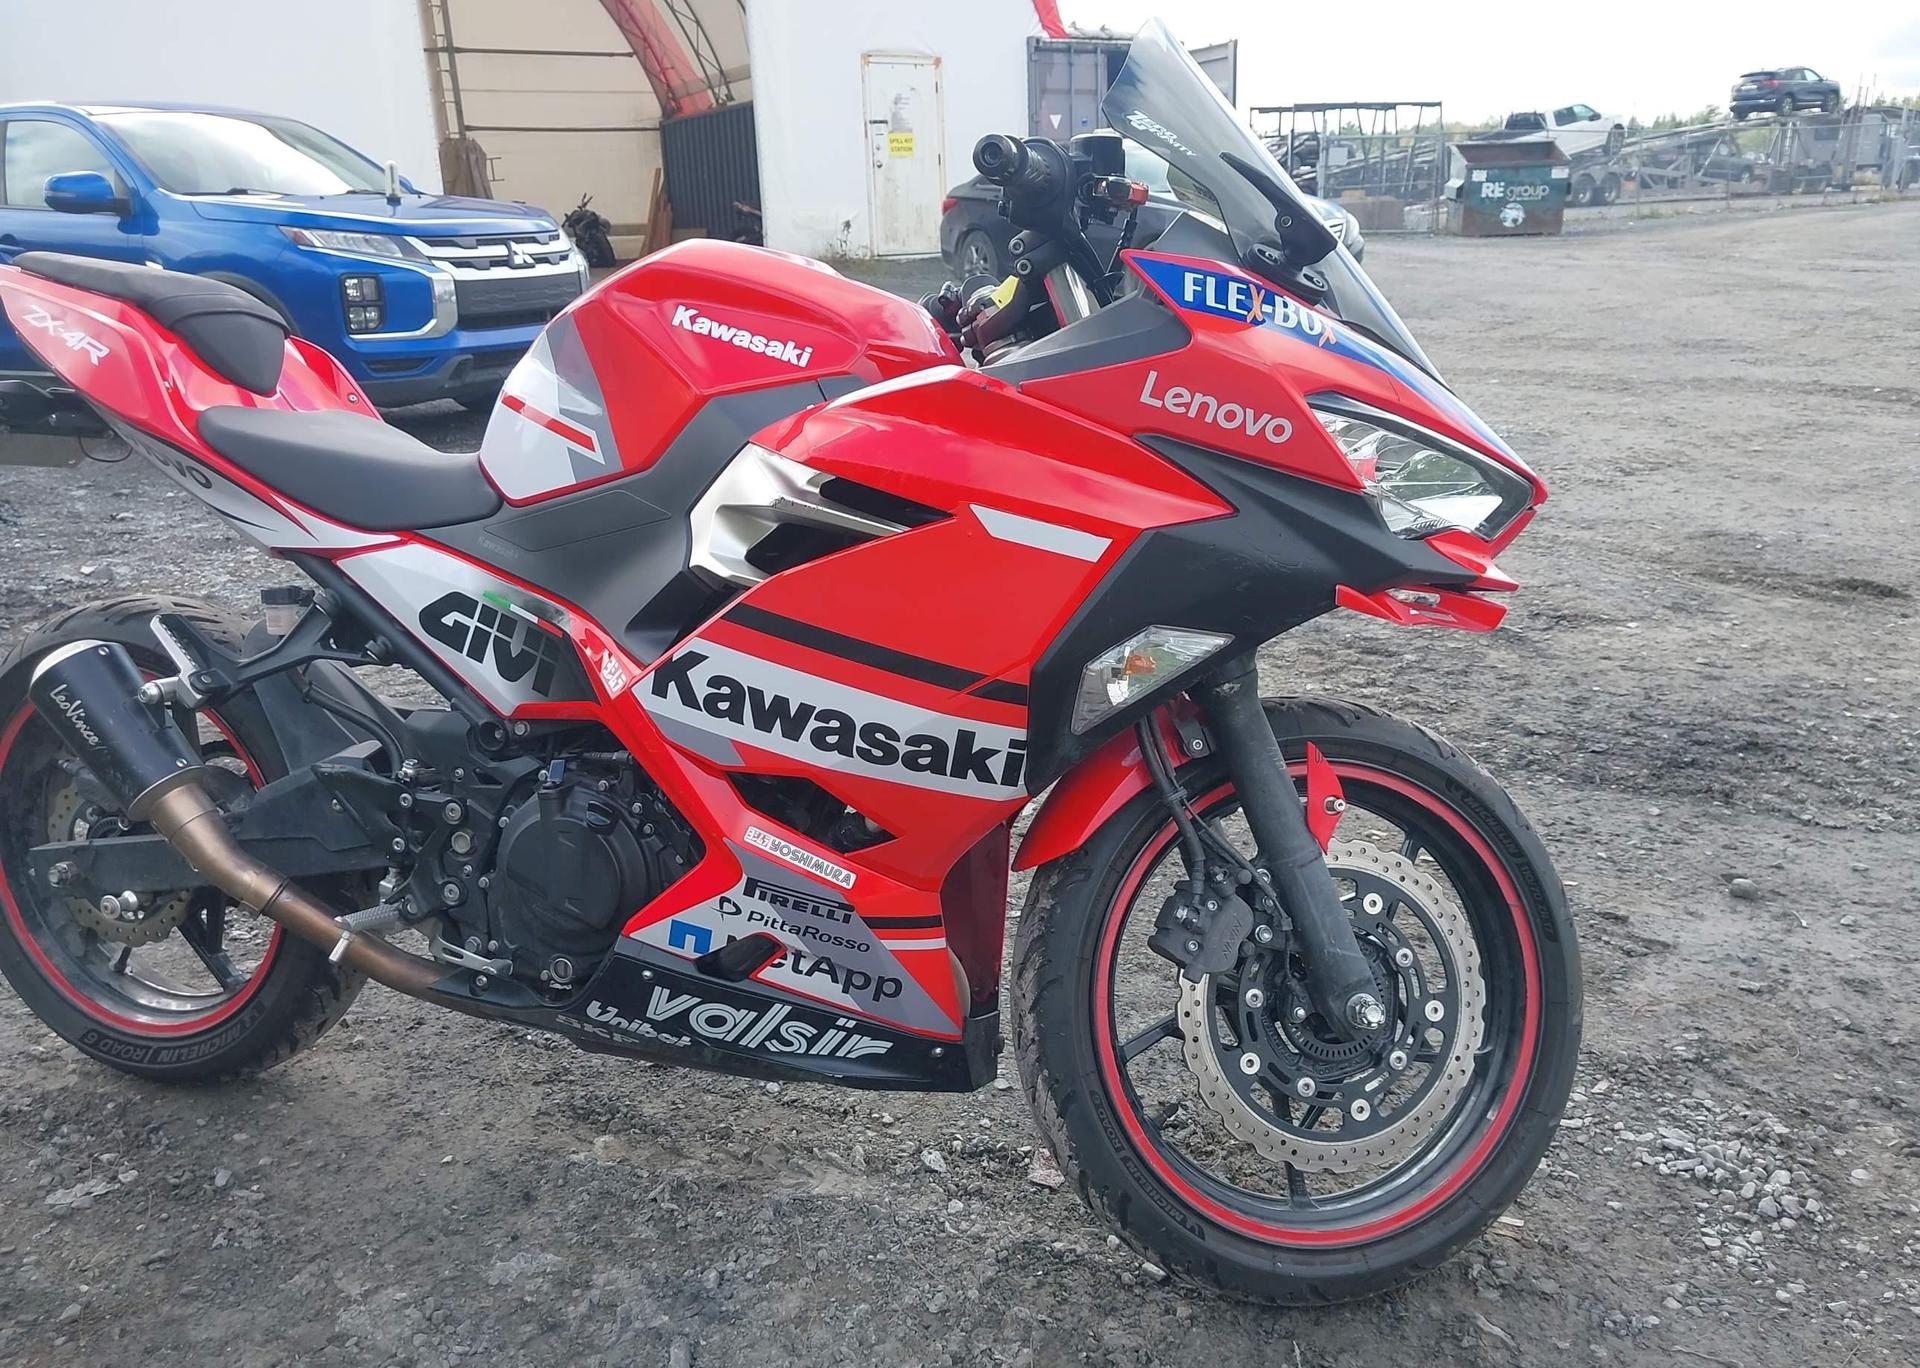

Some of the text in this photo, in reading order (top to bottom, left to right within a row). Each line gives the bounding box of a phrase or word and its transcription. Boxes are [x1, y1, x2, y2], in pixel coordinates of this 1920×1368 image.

[1506, 185, 1550, 200] group
[23, 304, 110, 366] ZX-4R
[671, 304, 814, 368] Kawasaki
[1139, 371, 1293, 444] Lenovo
[419, 591, 558, 697] GIVI
[50, 683, 101, 746] LeoVince
[651, 650, 1028, 787] Kawasaki
[770, 838, 852, 887] YOSHIMURA
[742, 876, 856, 924] PIRELLI
[747, 910, 871, 953] PittaRosso
[726, 933, 903, 1002] tApp
[84, 1024, 242, 1063] MICHELIN ROAD 6
[586, 1000, 692, 1047] Unibat
[645, 985, 894, 1059] valsir
[1098, 1107, 1122, 1150] ROAD
[1124, 1160, 1185, 1223] MICHELIN
